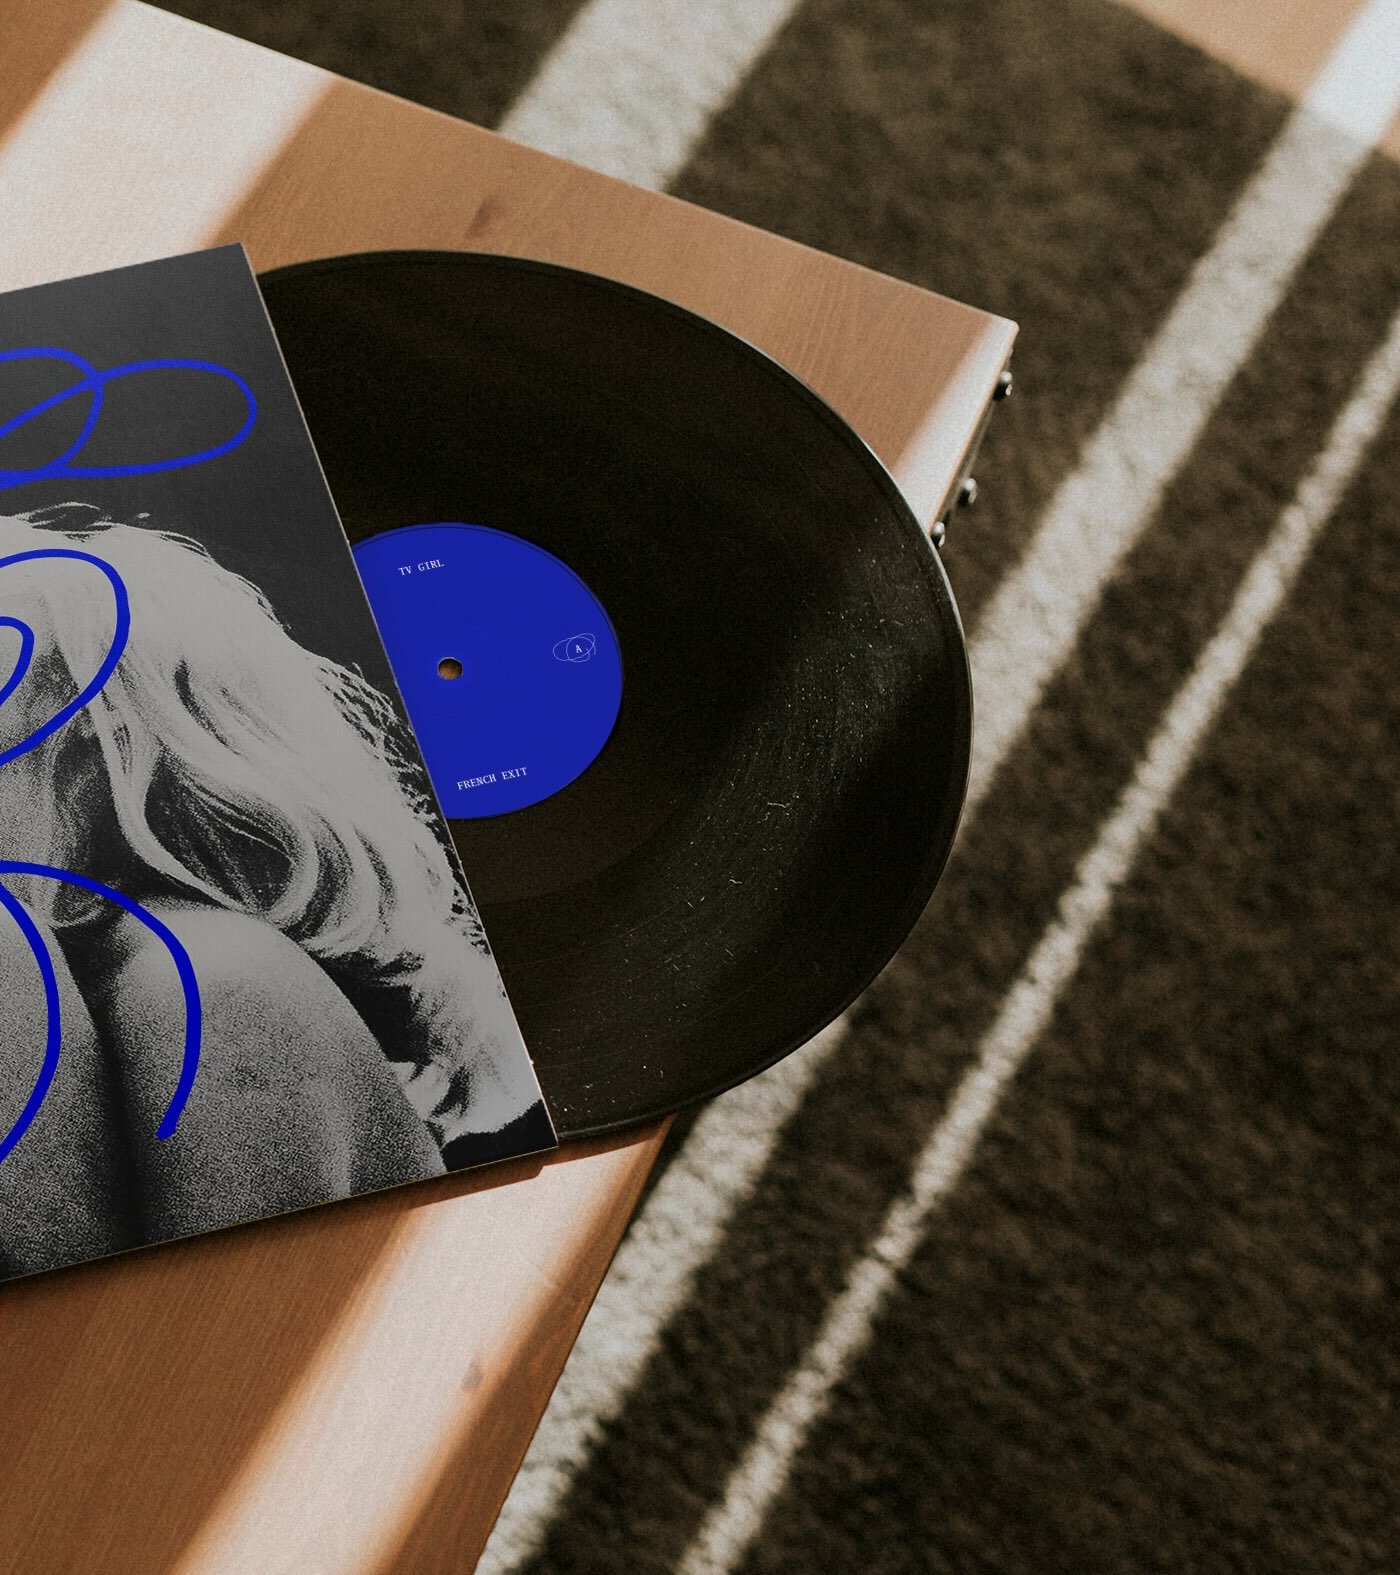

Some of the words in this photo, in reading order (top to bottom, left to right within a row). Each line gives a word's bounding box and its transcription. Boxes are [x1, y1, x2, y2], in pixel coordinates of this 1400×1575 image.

[398, 566, 412, 576] TV
[418, 559, 444, 572] GIRL
[575, 644, 583, 654] A
[457, 773, 497, 790] FRENCH
[501, 766, 528, 780] EXIT
